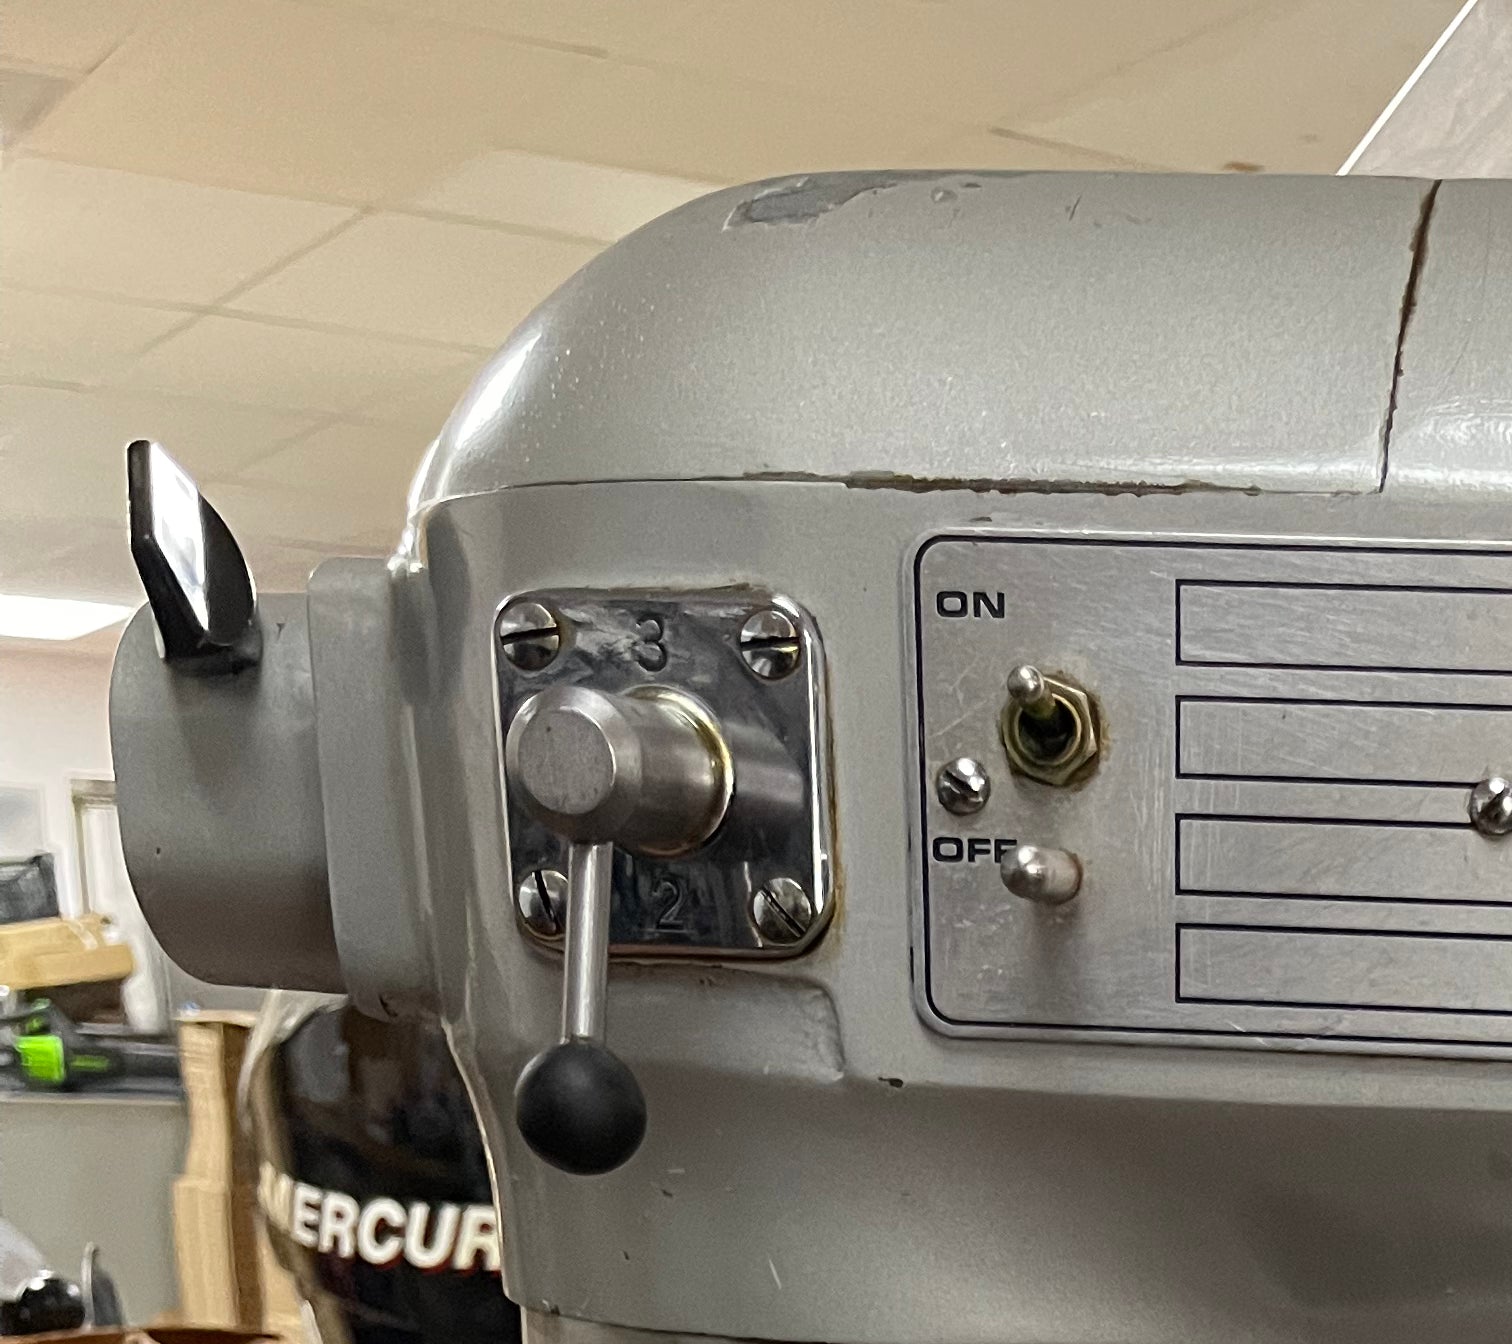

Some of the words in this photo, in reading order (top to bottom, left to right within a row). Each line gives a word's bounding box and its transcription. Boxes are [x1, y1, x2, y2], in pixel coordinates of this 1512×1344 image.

[936, 591, 1005, 619] ON
[933, 837, 1017, 863] OFF
[652, 879, 689, 930] 2
